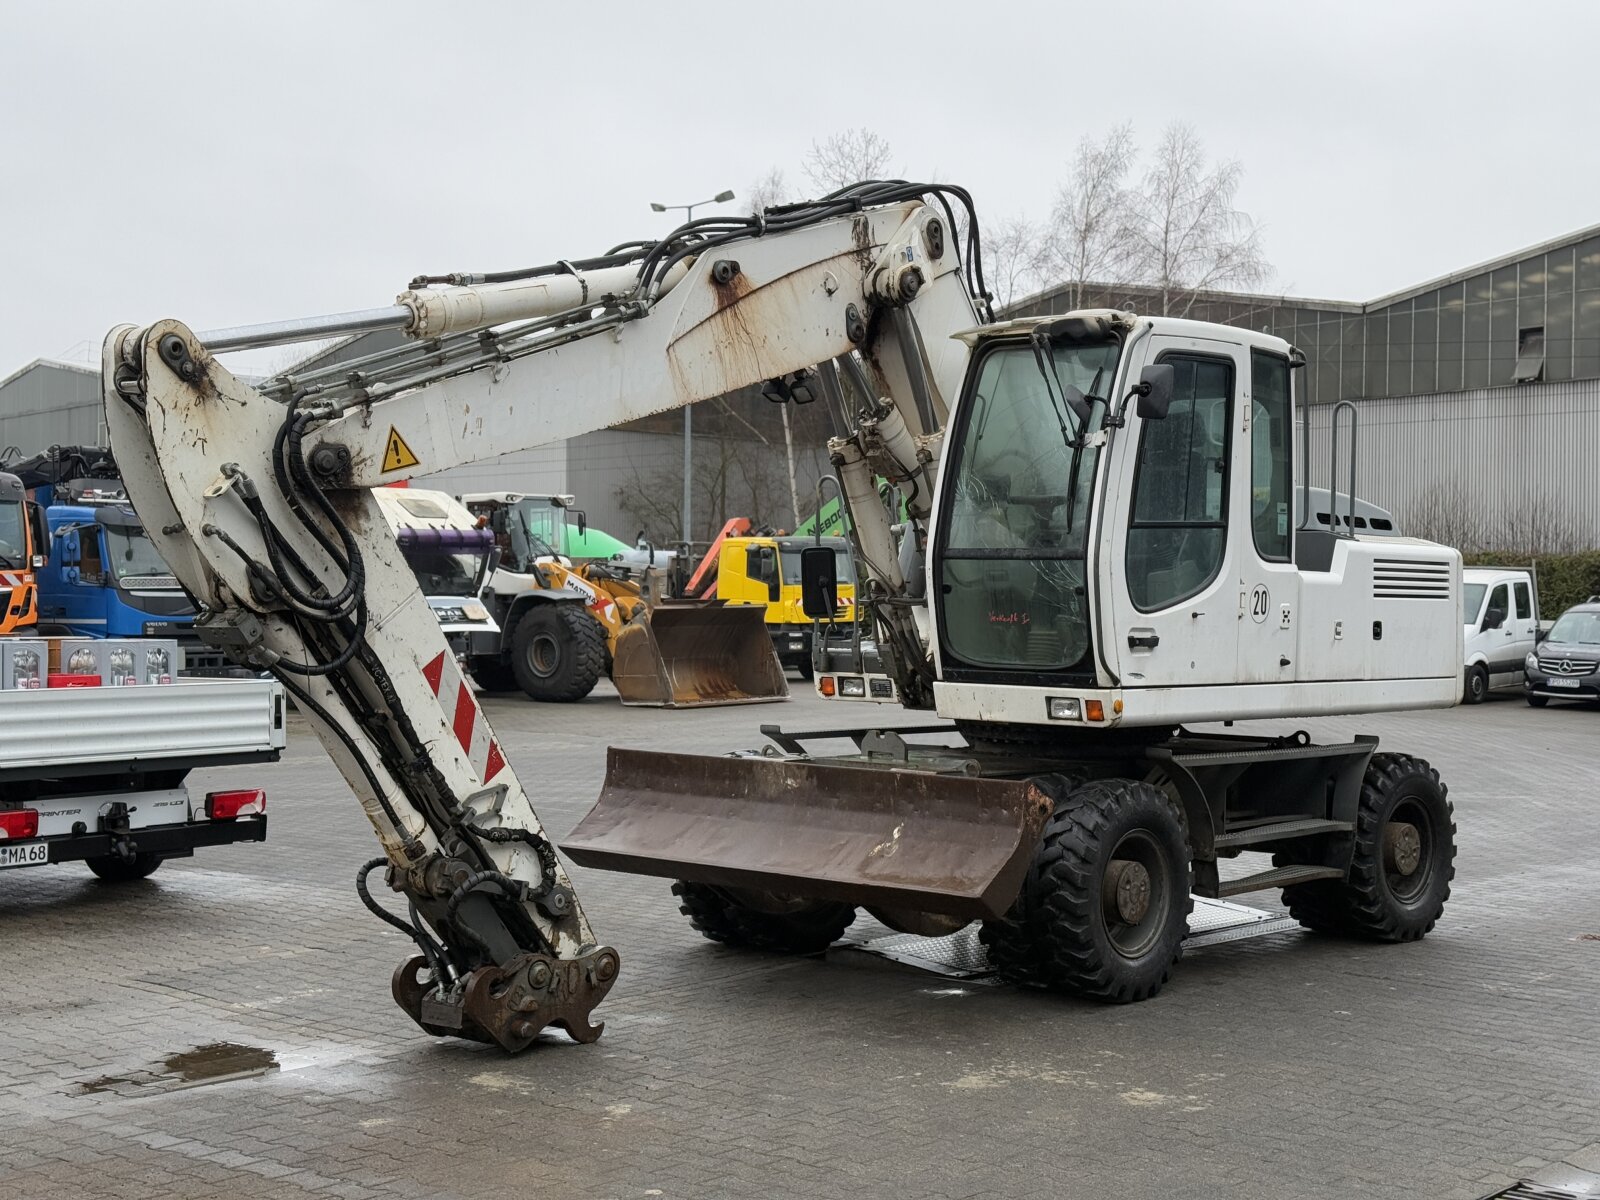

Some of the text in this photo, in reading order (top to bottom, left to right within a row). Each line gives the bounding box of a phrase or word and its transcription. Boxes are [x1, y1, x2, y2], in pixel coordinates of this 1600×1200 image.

[1253, 590, 1267, 615] 20
[8, 845, 46, 863] MA 68
